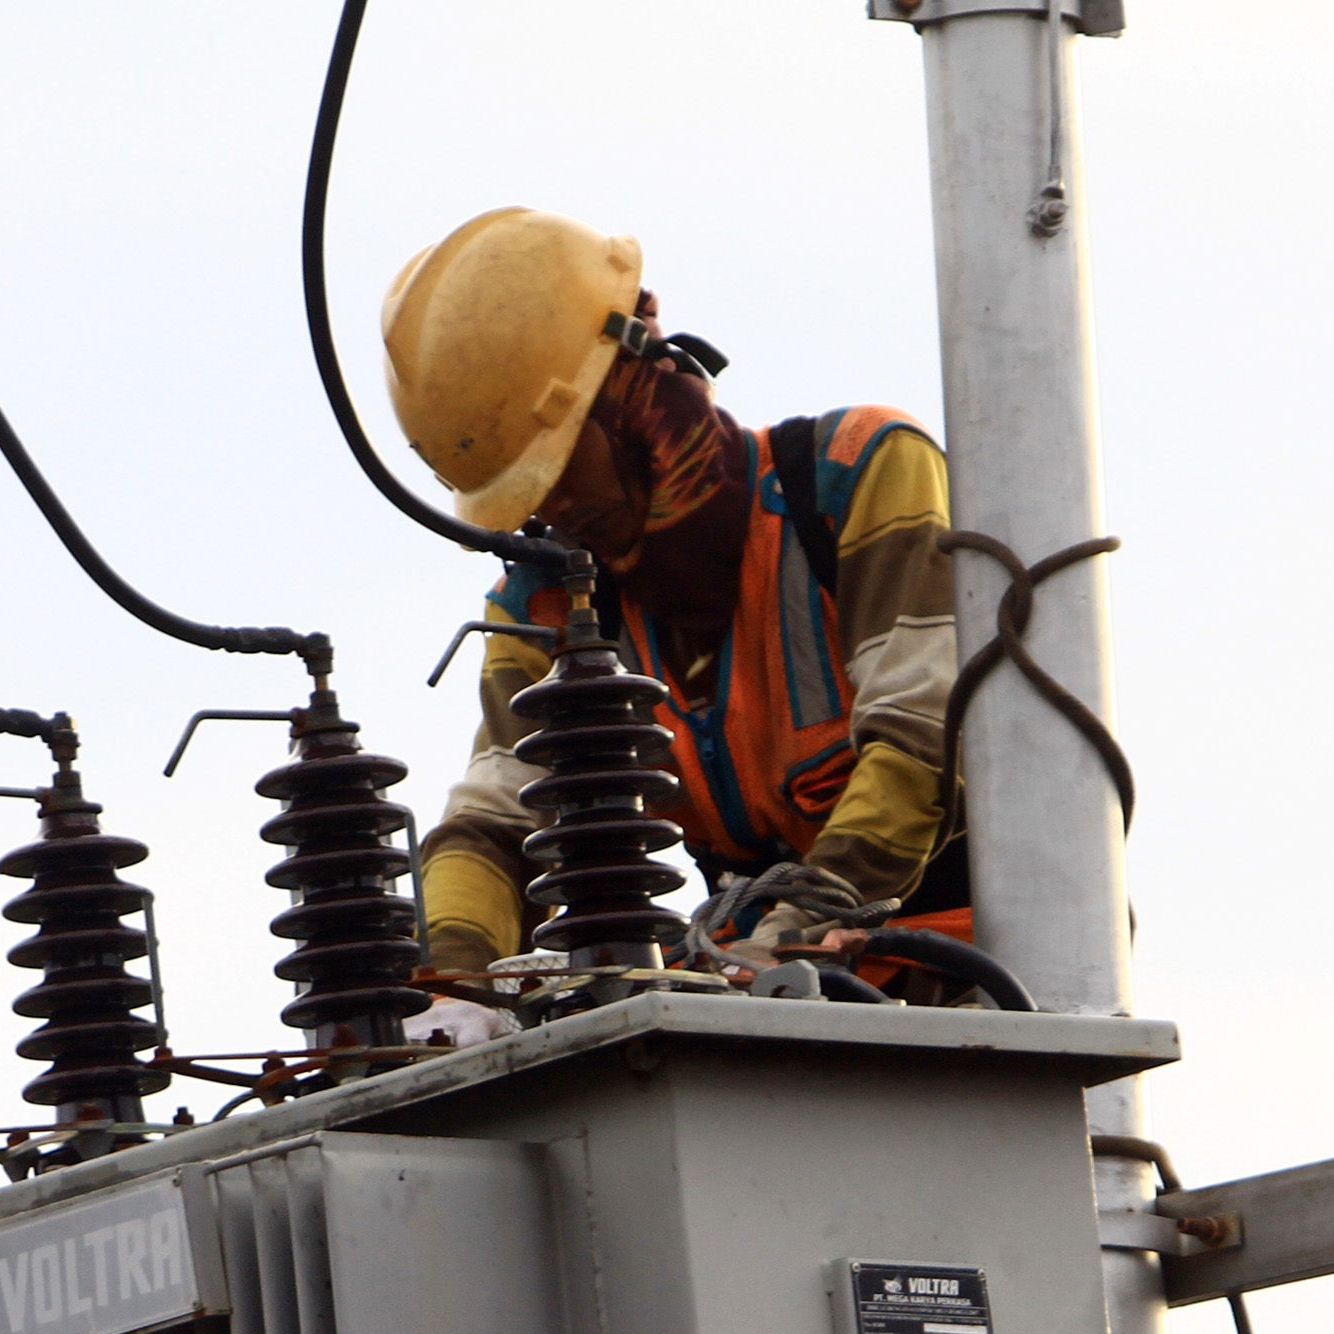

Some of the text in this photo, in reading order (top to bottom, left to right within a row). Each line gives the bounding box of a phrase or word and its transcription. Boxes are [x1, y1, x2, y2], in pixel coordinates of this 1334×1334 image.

[908, 1277, 959, 1296] VOLTRA
[887, 1294, 909, 1303] MEGA
[910, 1295, 936, 1304] KARYA
[936, 1296, 972, 1306] PERKASA
